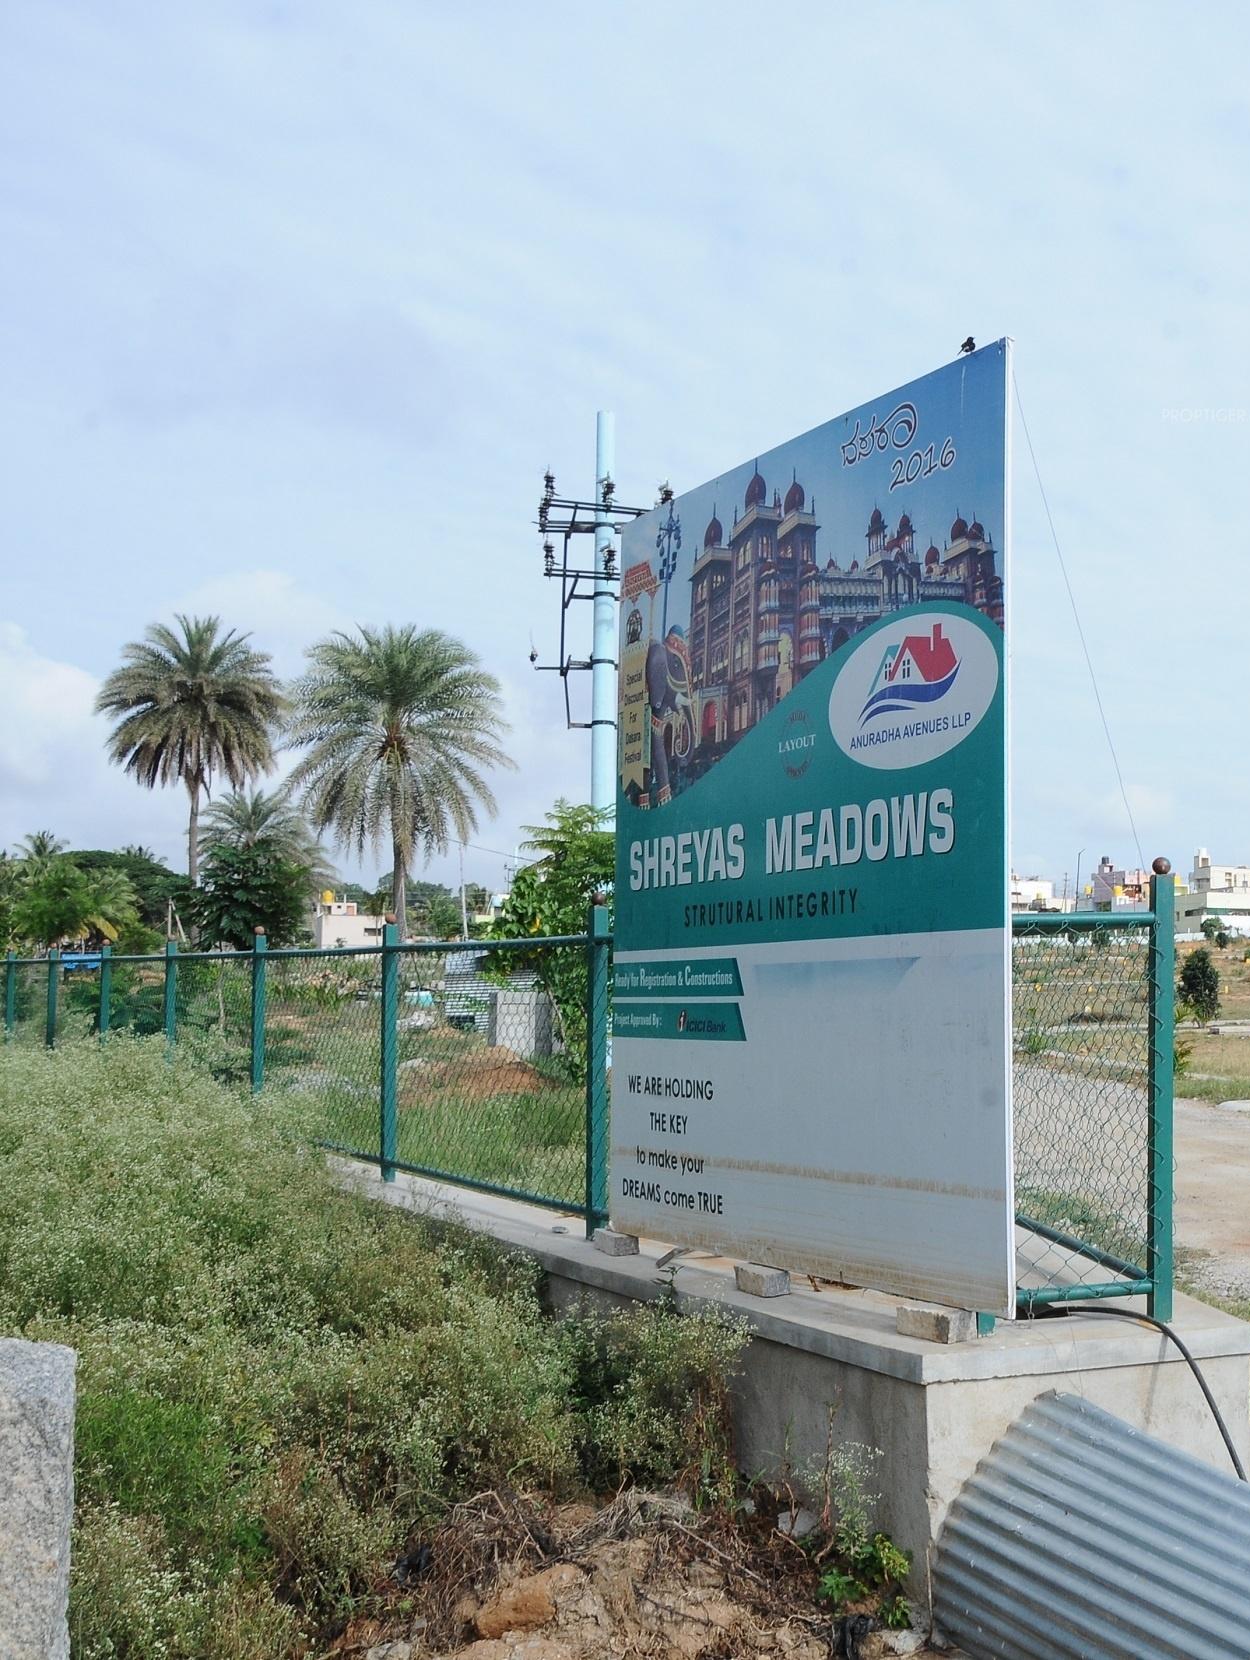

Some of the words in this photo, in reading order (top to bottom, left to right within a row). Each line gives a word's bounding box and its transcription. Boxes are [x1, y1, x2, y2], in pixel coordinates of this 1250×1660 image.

[889, 436, 956, 493] 2016
[778, 733, 817, 753] LAYOUT
[850, 727, 901, 750] ANURADHA
[903, 716, 949, 739] AVENUES
[952, 712, 971, 729] LLP
[629, 823, 746, 891] SHREYAS
[765, 788, 955, 875] MEADOWS
[684, 899, 764, 928] STRUTURAL
[769, 887, 858, 921] INTEGRITY
[640, 968, 677, 990] Registration
[677, 971, 684, 986] &
[684, 965, 733, 986] Constructions
[686, 1019, 705, 1032] ICICI
[707, 1019, 726, 1033] Bank
[628, 1075, 641, 1094] WE
[644, 1076, 662, 1096] ARE
[664, 1078, 714, 1100] HOLDING
[649, 1112, 667, 1132] THE
[669, 1114, 688, 1135] KEY
[636, 1145, 646, 1165] to
[648, 1149, 678, 1170] make
[680, 1156, 704, 1176] your
[622, 1178, 661, 1203] DREAMS
[663, 1190, 695, 1209] come
[697, 1192, 723, 1214] TRUE
